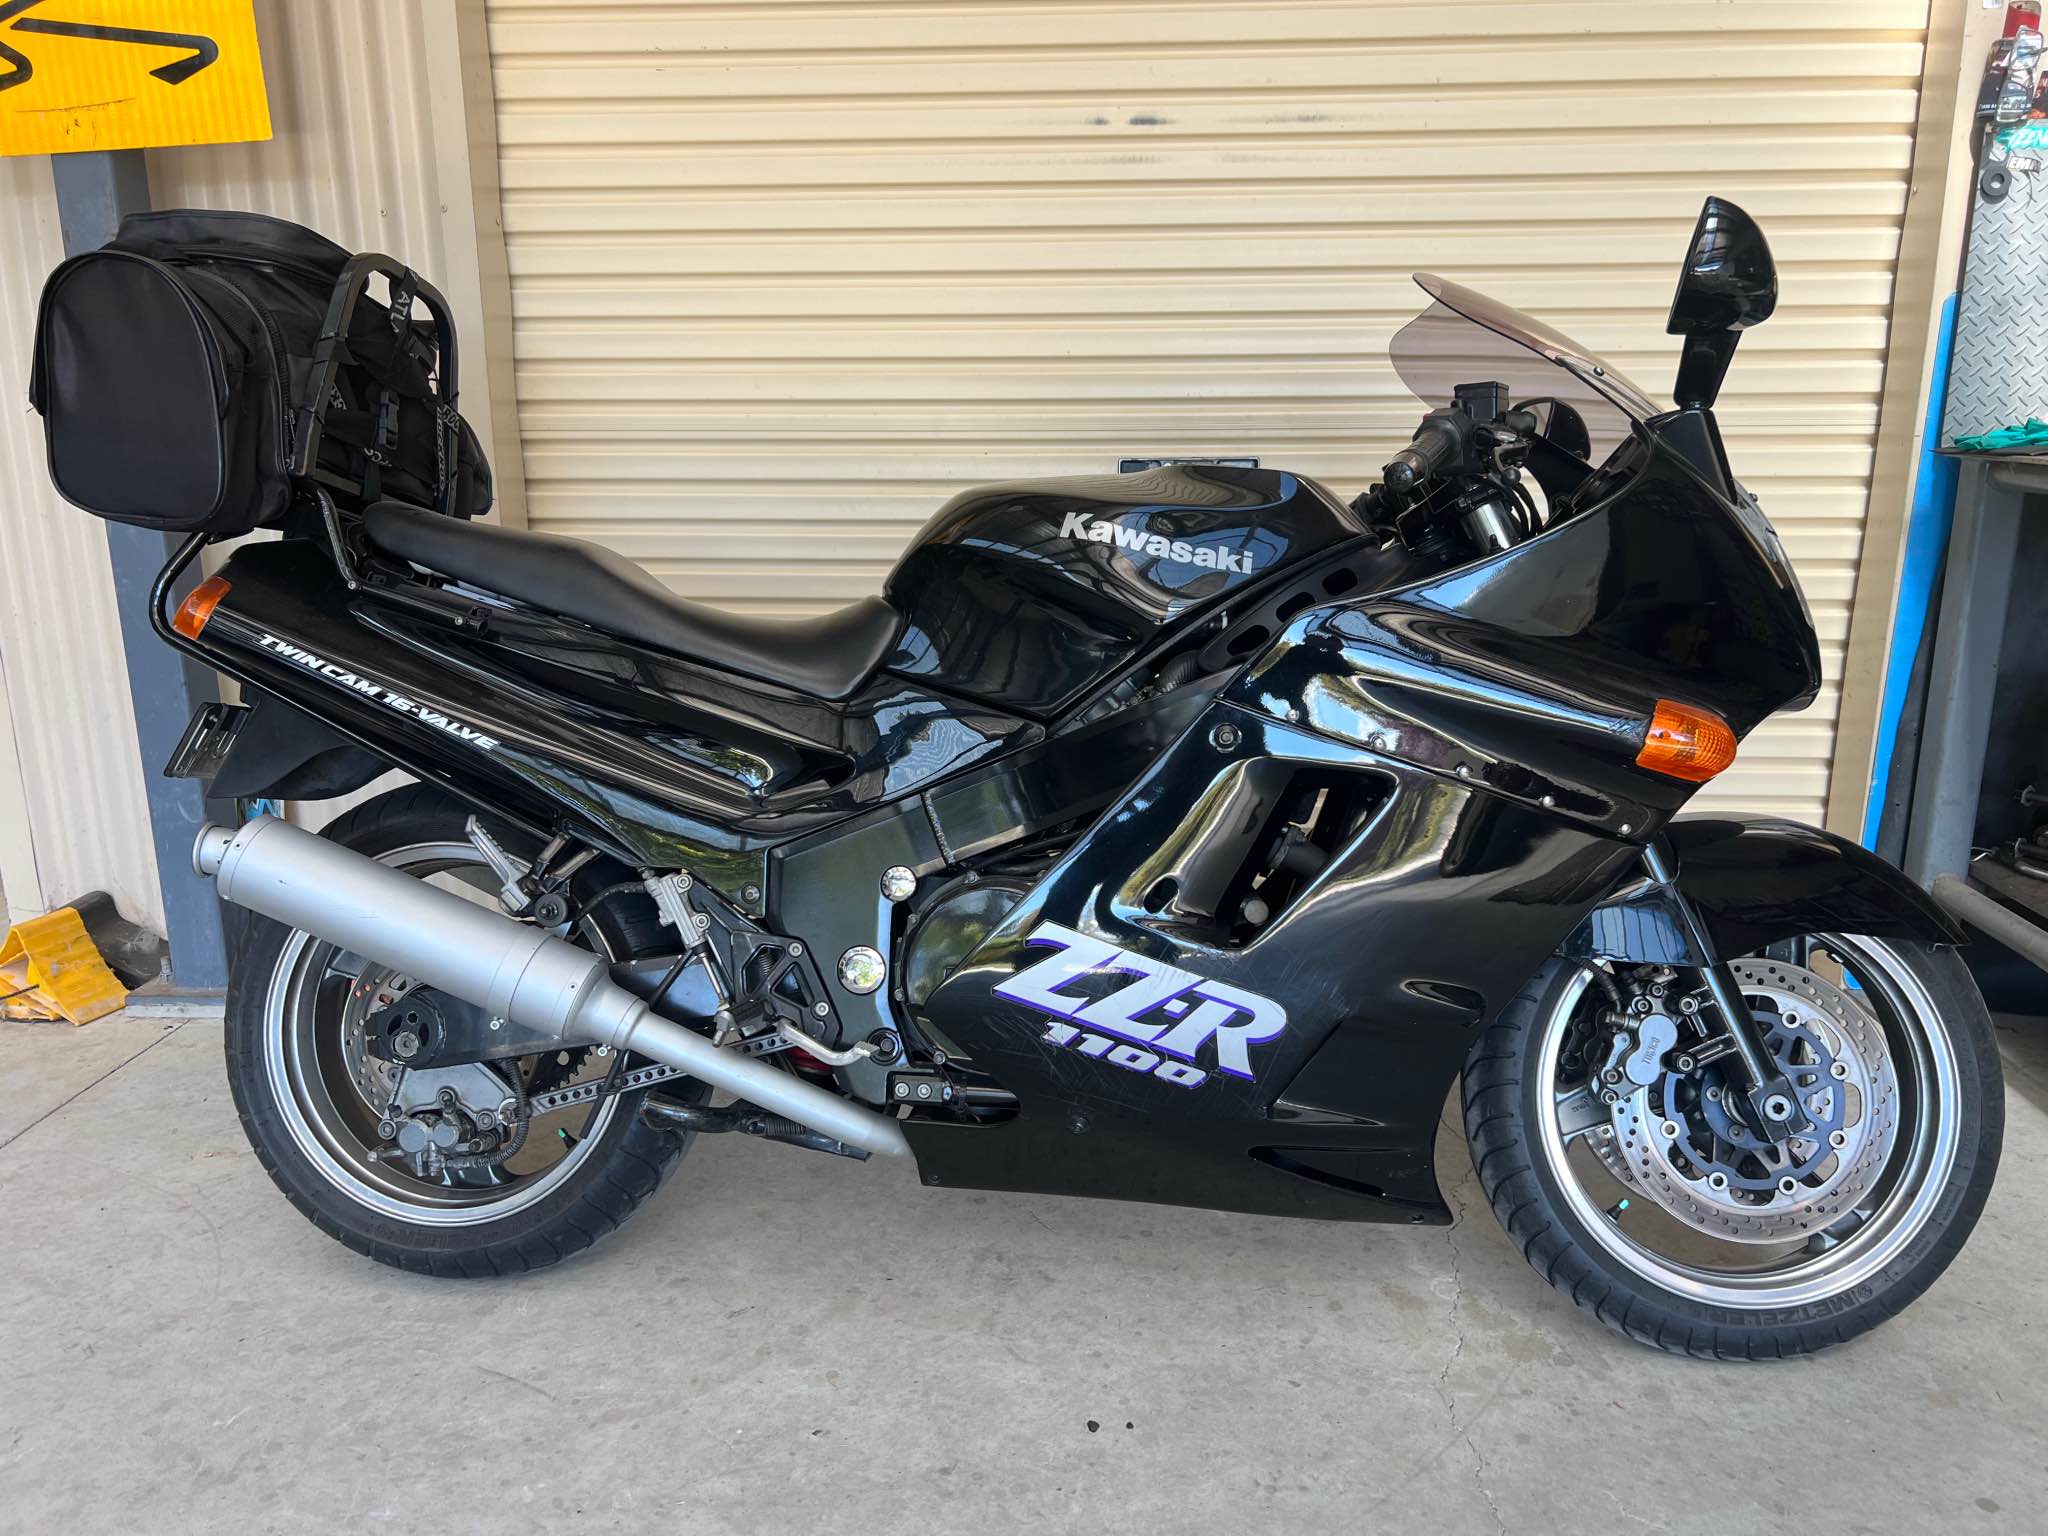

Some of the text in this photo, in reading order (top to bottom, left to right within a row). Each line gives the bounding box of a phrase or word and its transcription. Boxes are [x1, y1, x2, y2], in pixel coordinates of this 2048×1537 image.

[1059, 511, 1254, 574] Kawasaki
[258, 633, 499, 750] TWIN CAM 16-VALVE
[1040, 1020, 1210, 1090] 1100
